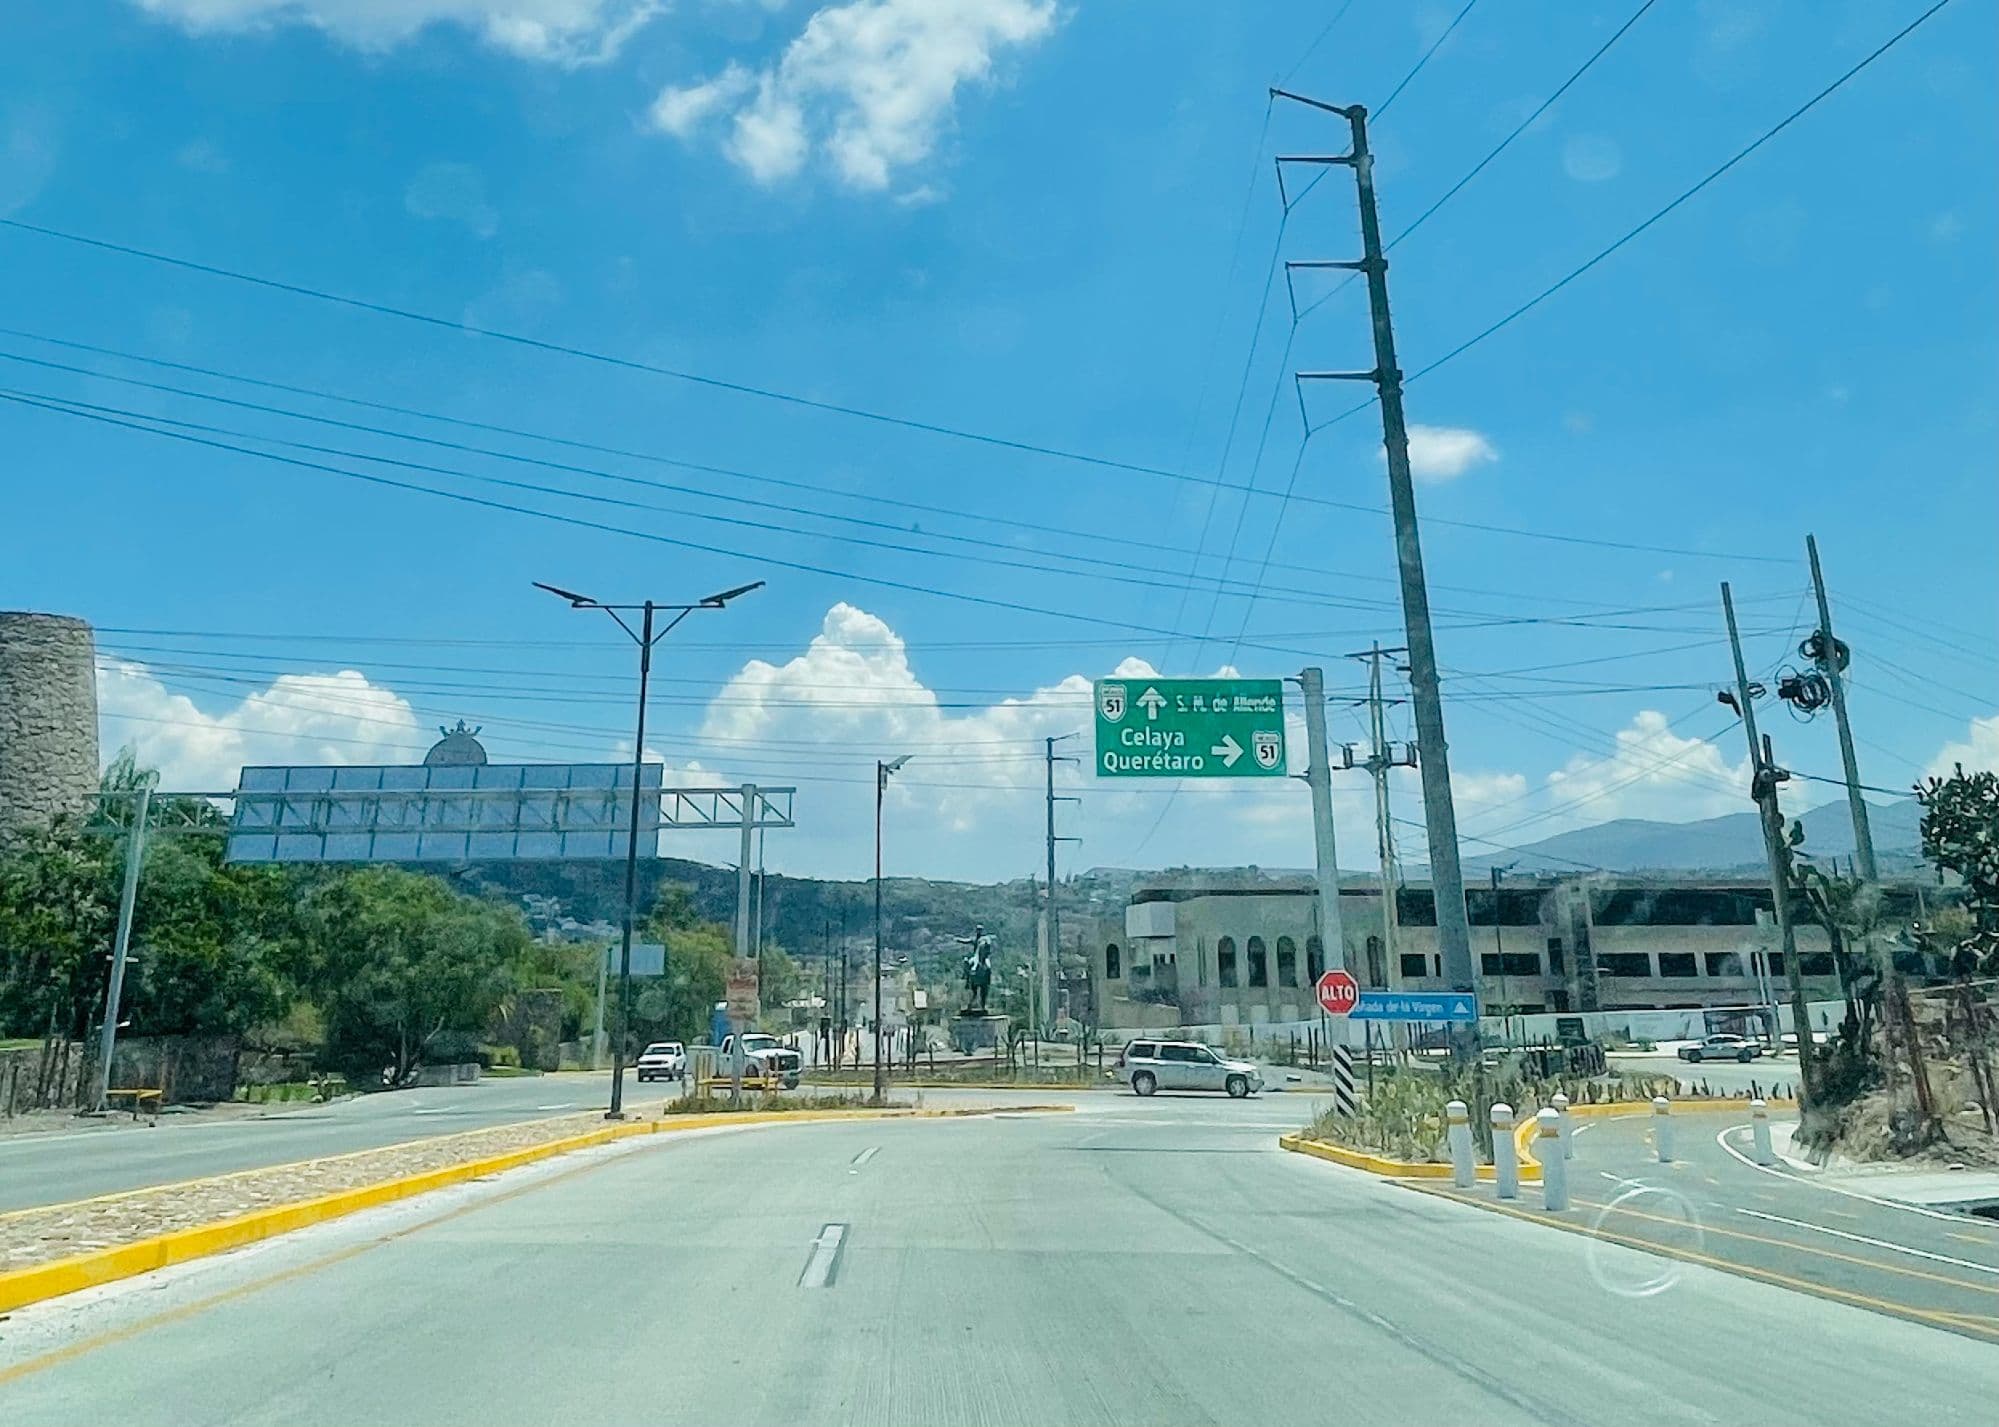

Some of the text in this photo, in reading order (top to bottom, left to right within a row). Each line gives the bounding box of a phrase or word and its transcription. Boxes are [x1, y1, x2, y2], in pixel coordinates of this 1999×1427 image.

[1106, 699, 1121, 713] 51
[1212, 693, 1228, 713] de
[1233, 694, 1276, 713] Allende
[1121, 726, 1185, 750] Celaya
[1103, 750, 1204, 773] Querétaro
[1260, 745, 1275, 760] 51
[1321, 985, 1354, 1001] ALTO
